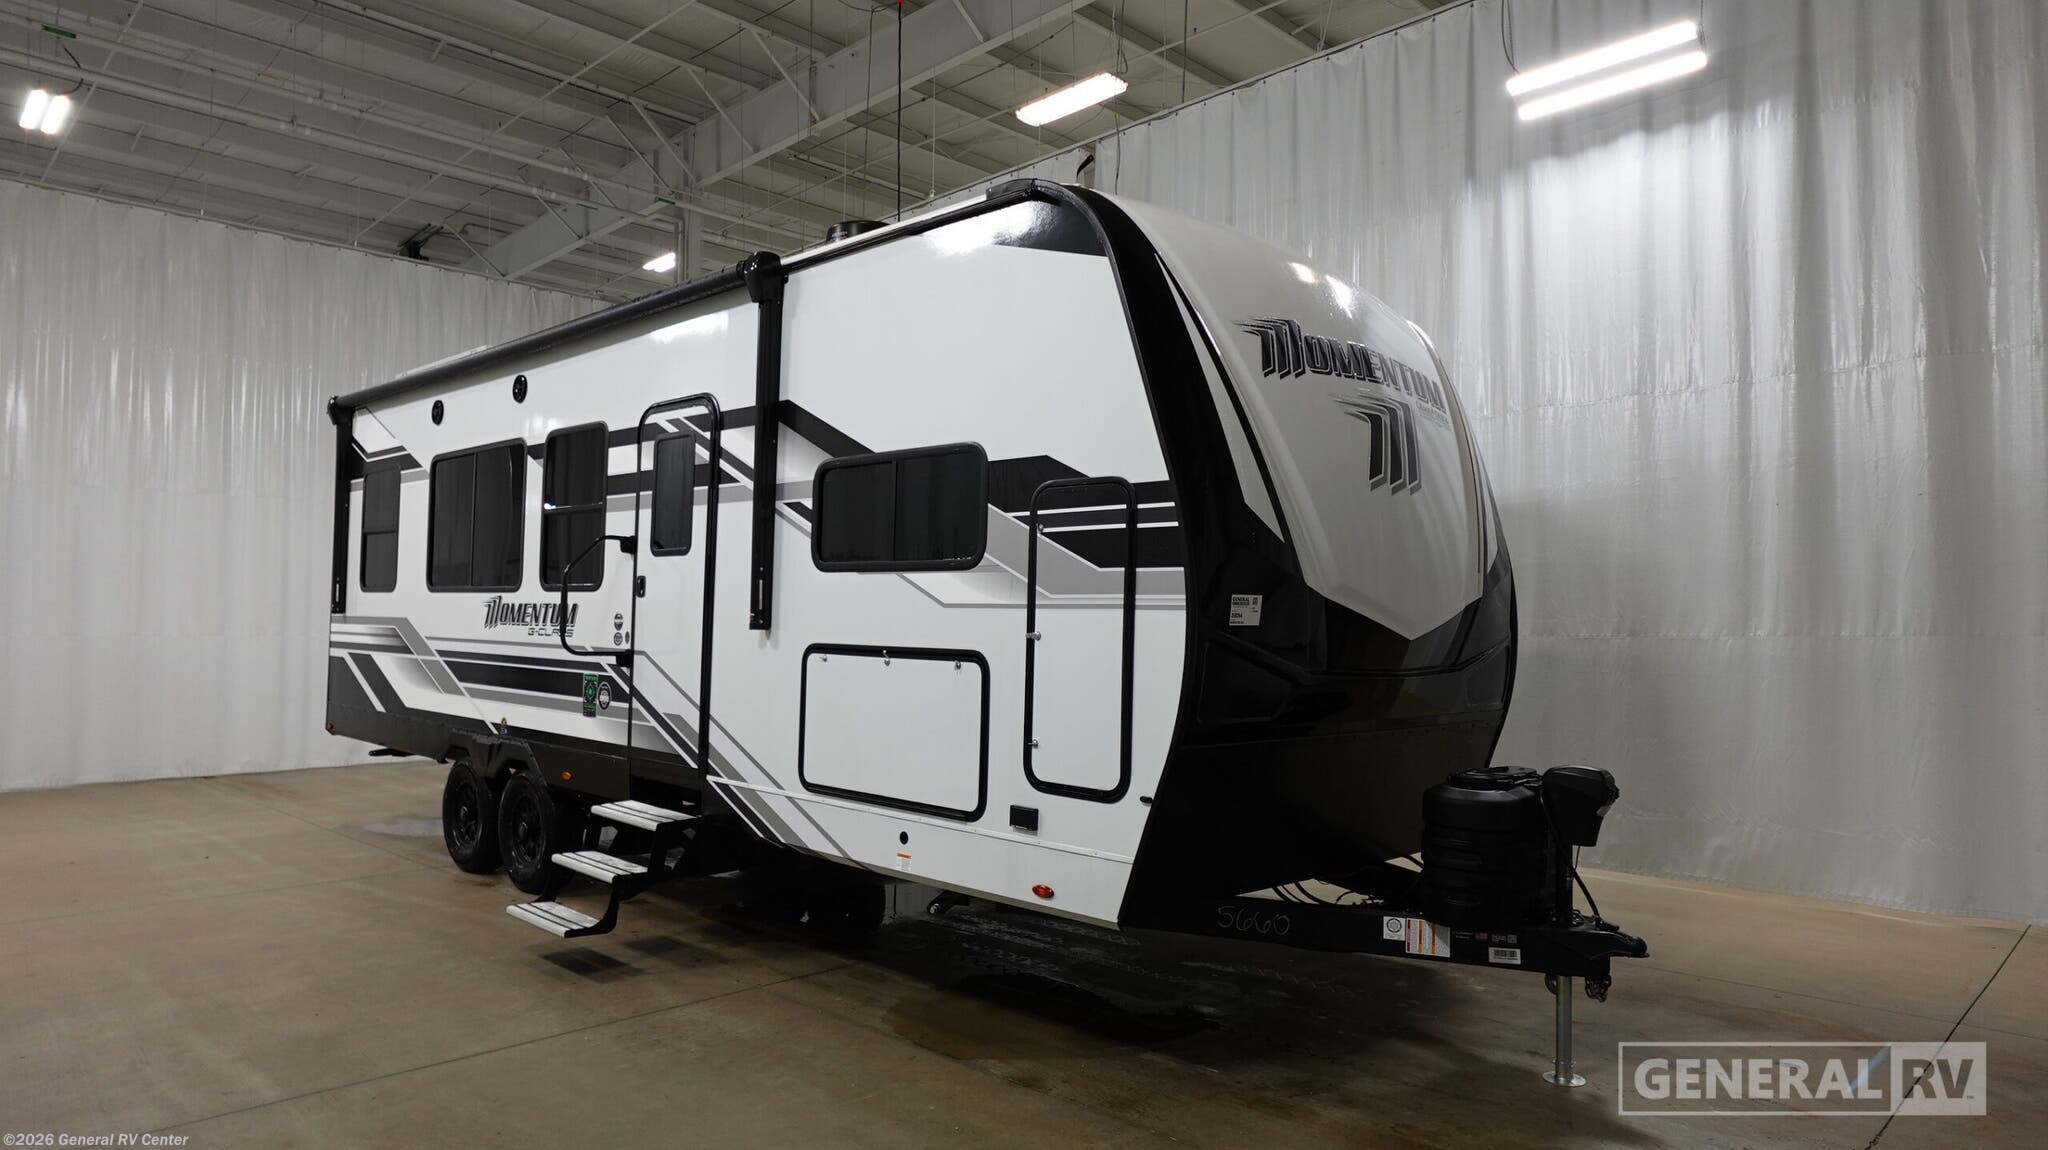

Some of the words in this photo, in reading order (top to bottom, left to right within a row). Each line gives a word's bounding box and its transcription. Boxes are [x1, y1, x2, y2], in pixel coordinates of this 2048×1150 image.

[1233, 315, 1448, 415] MOMENTUM
[483, 595, 578, 629] MOMENTUM
[528, 627, 574, 638] G-CLAS
[1217, 905, 1290, 936] 5660
